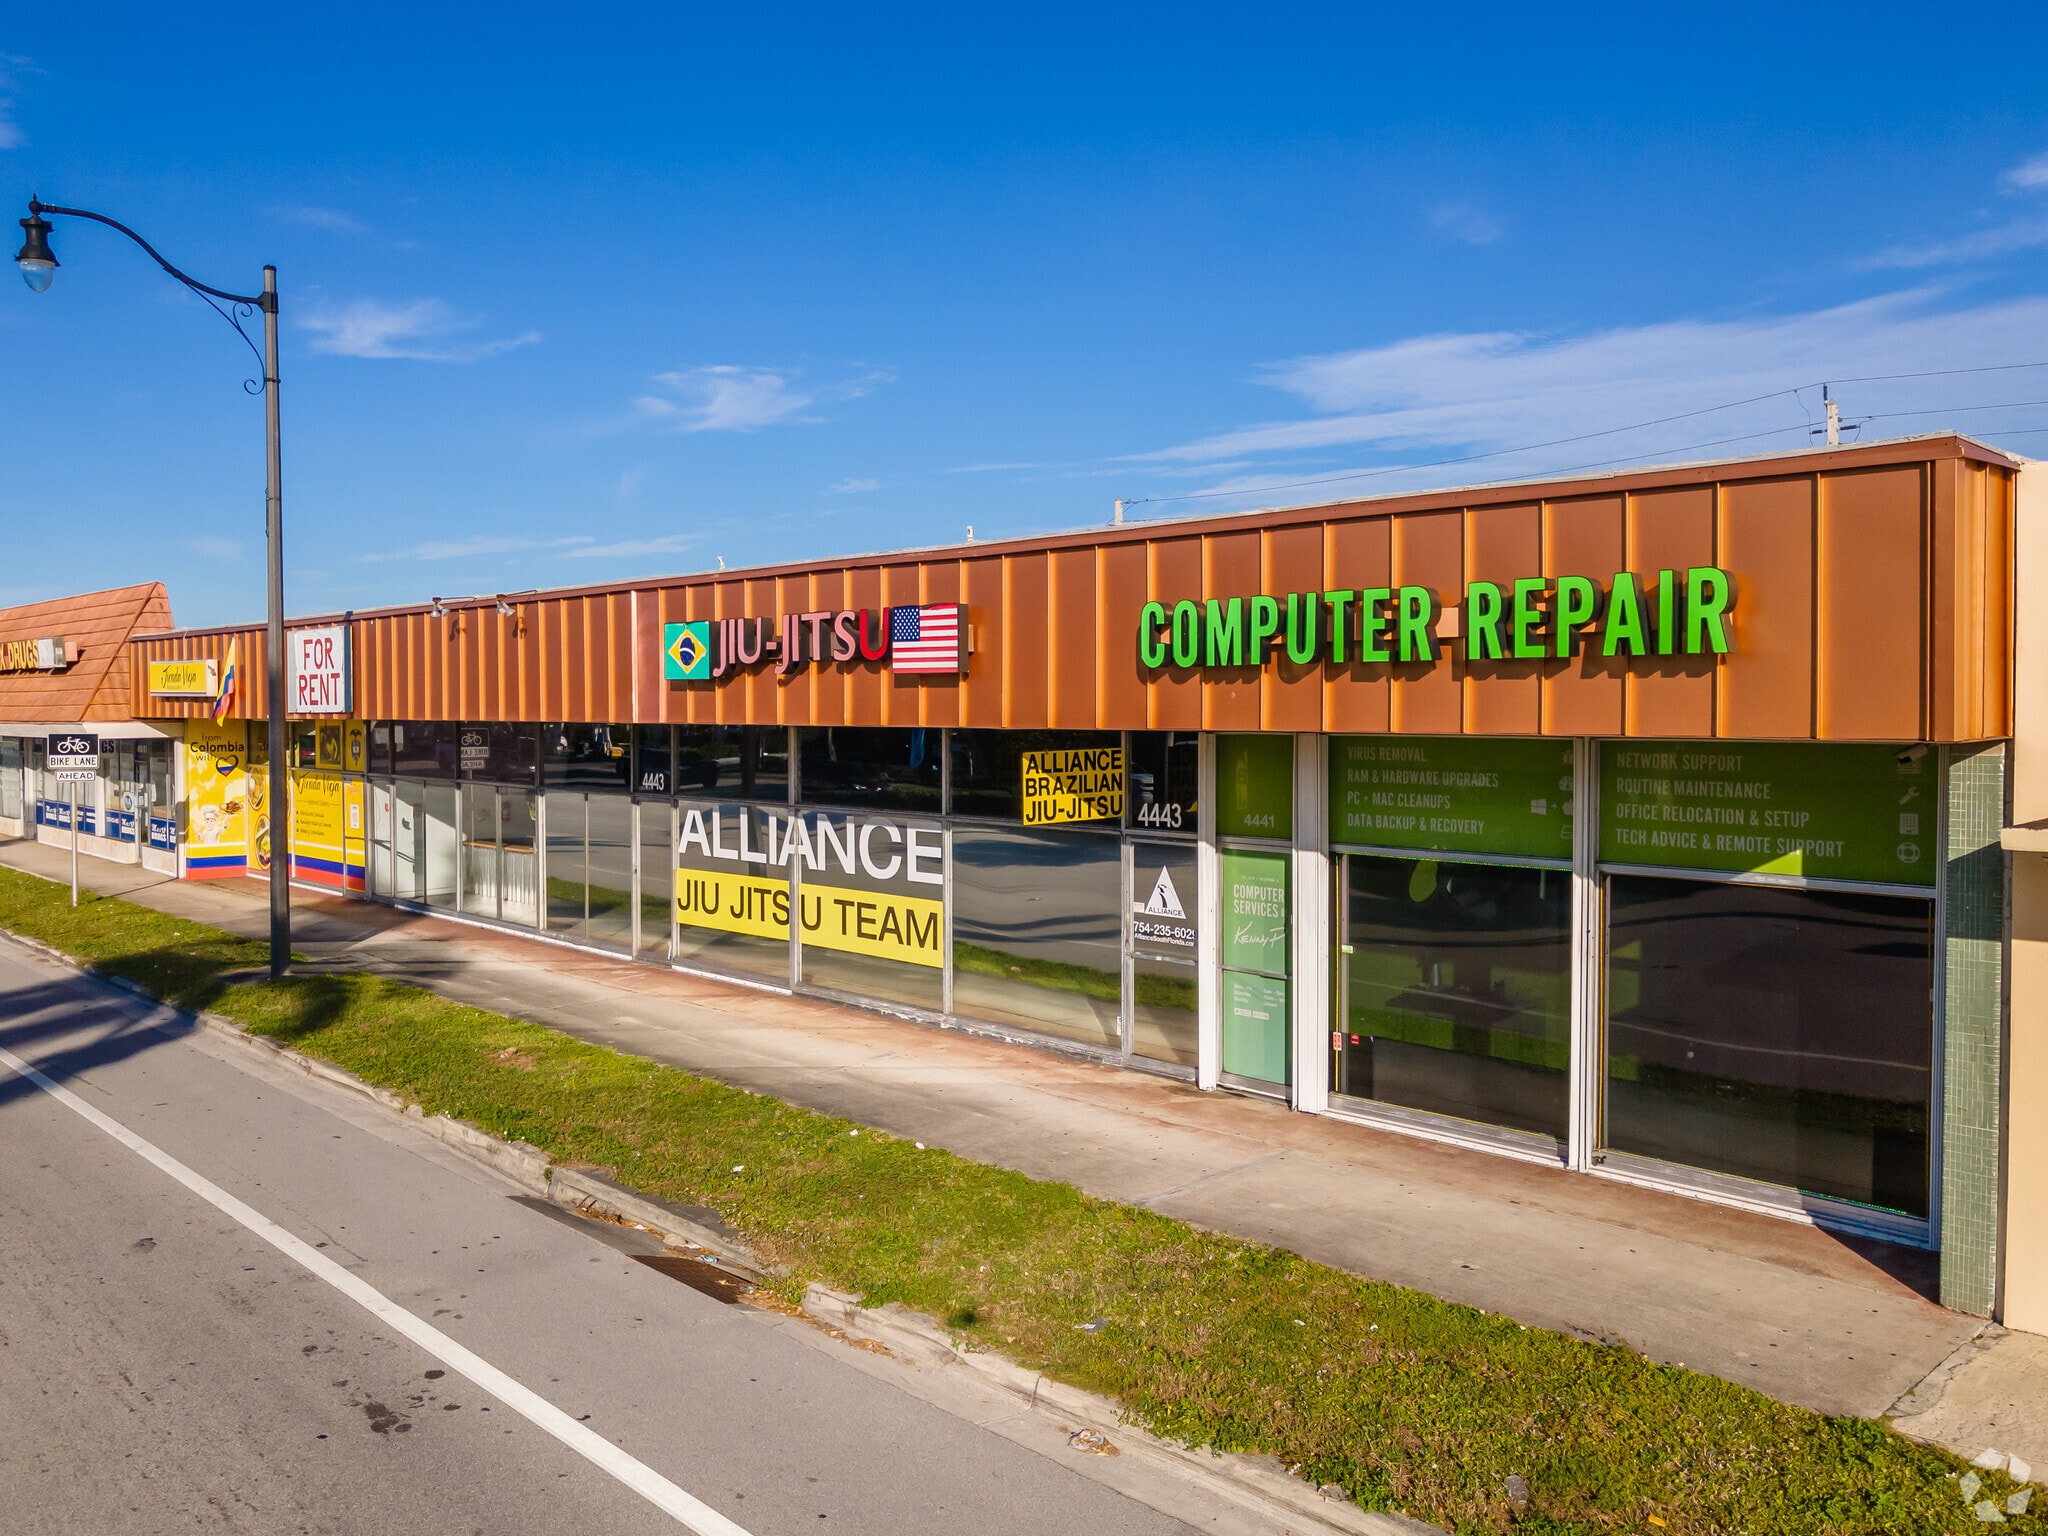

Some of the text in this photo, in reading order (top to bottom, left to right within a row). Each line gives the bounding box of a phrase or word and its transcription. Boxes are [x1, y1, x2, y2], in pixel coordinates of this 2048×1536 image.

[1140, 566, 1734, 669] COMPUTER REPAIR
[713, 607, 891, 678] JIU-JITSU
[7, 638, 39, 670] DRUGS
[303, 637, 335, 671] FOR
[299, 672, 340, 706] RENT
[190, 741, 245, 753] Colombia
[201, 733, 222, 742] from
[50, 756, 97, 766] BIKE LANE
[1026, 750, 1122, 775] ALLIANCE
[1348, 747, 1426, 762] VIRUS REMOVAL
[1616, 752, 1743, 772] NETWORK SUPPORT
[58, 772, 93, 780] AHEAD
[642, 772, 665, 791] 4443
[1025, 773, 1123, 797] BRAZILIAN
[1348, 769, 1499, 788] RAM & HARDWARE UPGRADES
[1616, 778, 1771, 800] ROUTINE MAINTENANCE
[1026, 795, 1123, 822] JIU-JITSU
[1348, 792, 1360, 805] PC
[1372, 792, 1394, 806] MAC
[1398, 794, 1451, 809] CLEANUPS
[1138, 802, 1182, 828] 4443
[1244, 814, 1275, 828] 4441
[1348, 814, 1484, 834] DATA BACKUP & RECOVERY
[1616, 804, 1809, 828] OFFICE RELOCATION & SETUP
[678, 804, 944, 885] ALLIANCE
[1616, 828, 1844, 858] TECH ADVICE & REMOTE SUPPORT
[1233, 884, 1284, 903] COMPUTER
[677, 879, 939, 951] JIU JITSU TEAM
[1148, 906, 1183, 916] ALLIANCE
[1233, 900, 1278, 918] SERVICES
